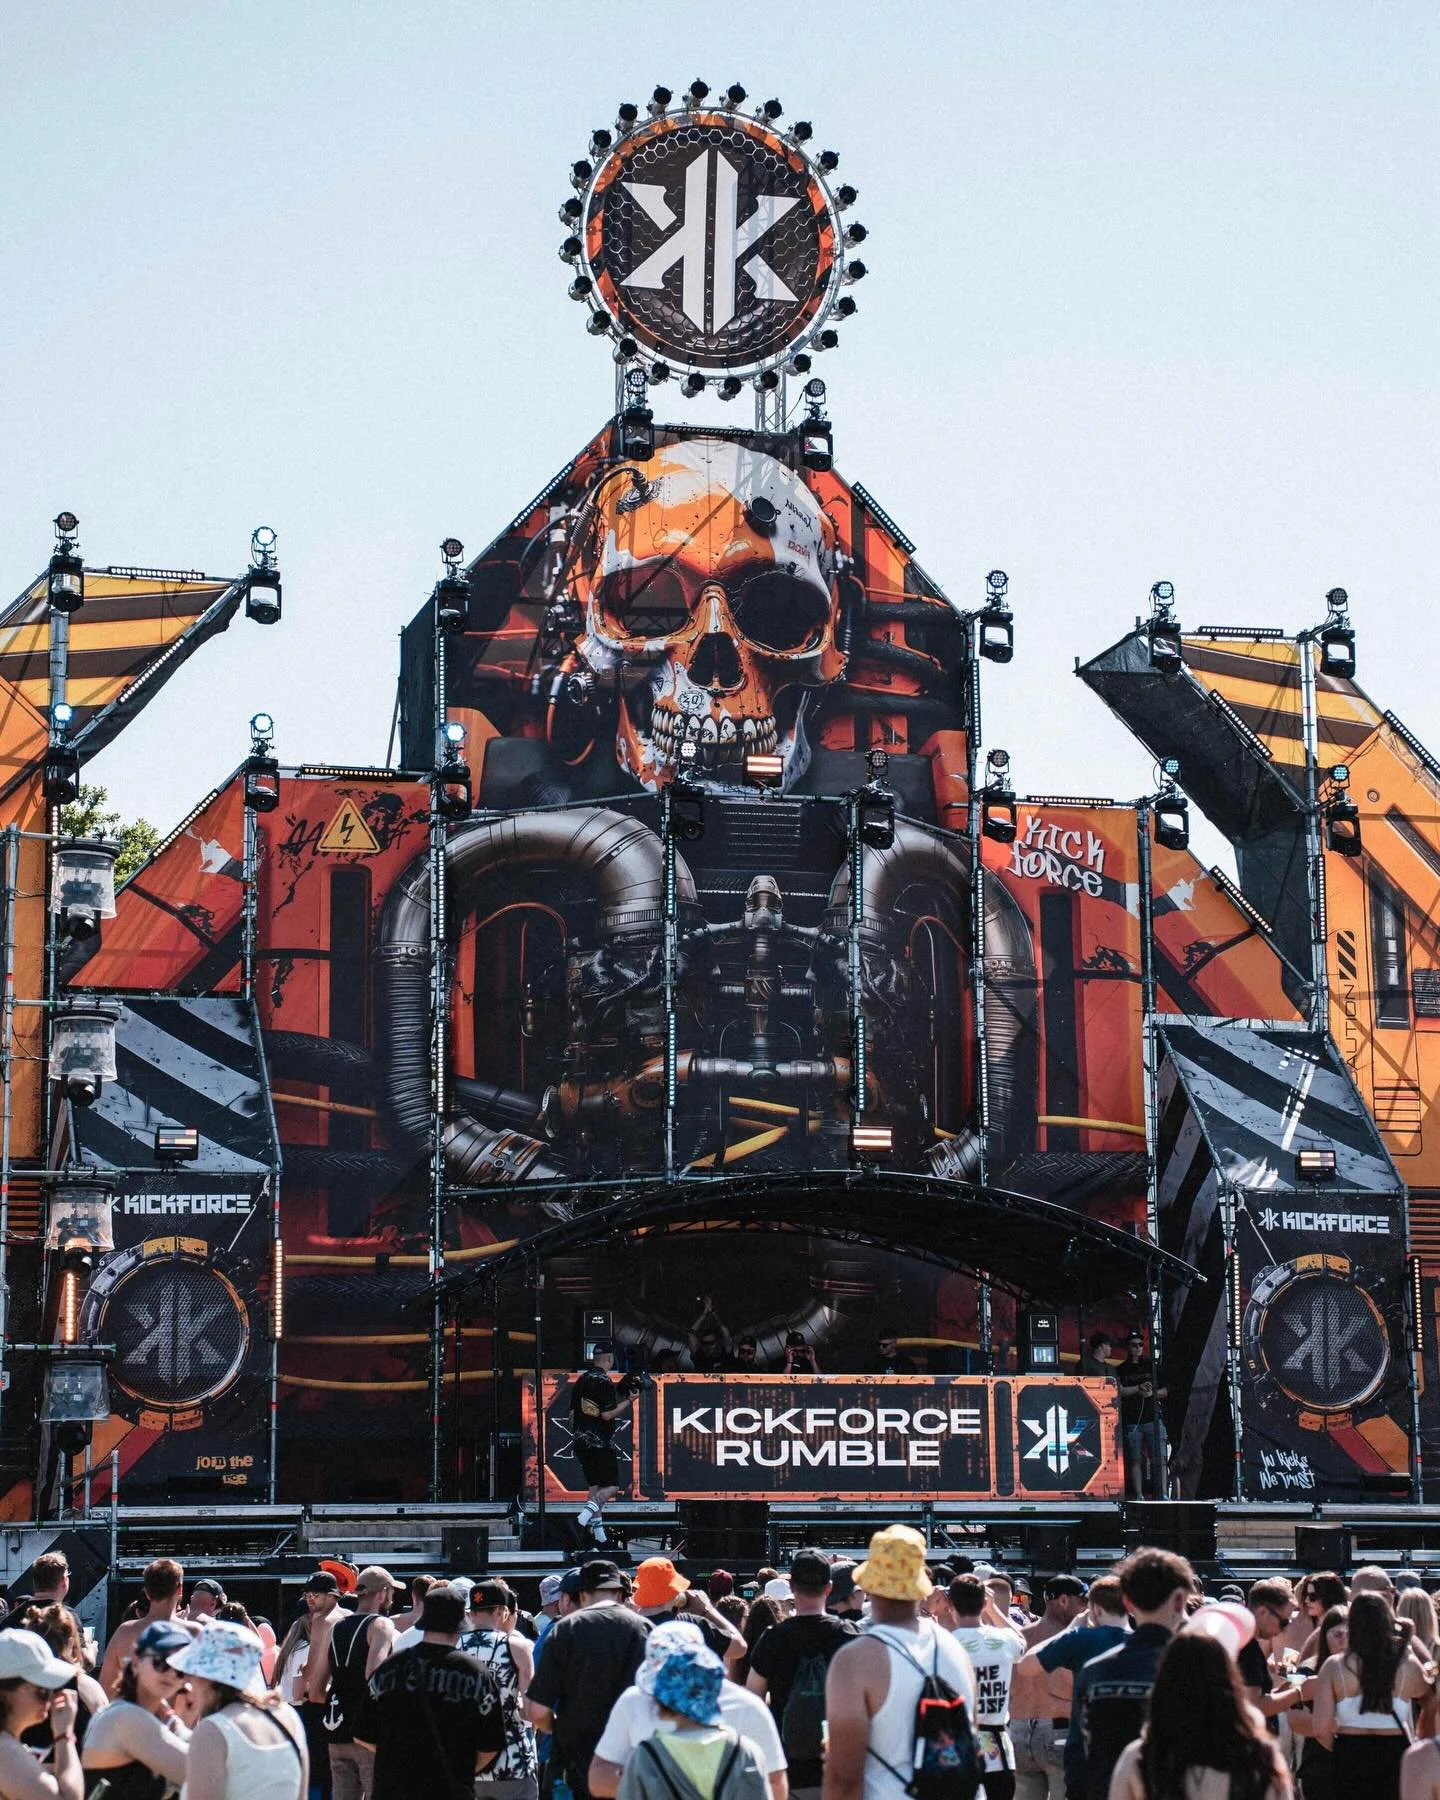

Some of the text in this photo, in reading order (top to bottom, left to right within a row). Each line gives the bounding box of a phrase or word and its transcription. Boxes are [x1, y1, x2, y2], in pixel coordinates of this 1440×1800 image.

[1026, 815, 1105, 874] KICK
[124, 1194, 251, 1214] KICKFORCE
[1282, 1211, 1390, 1234] KICKFORCE
[672, 1407, 981, 1435] KICKFORCE
[716, 1440, 940, 1466] RUMBLE
[974, 1664, 1000, 1682] HE
